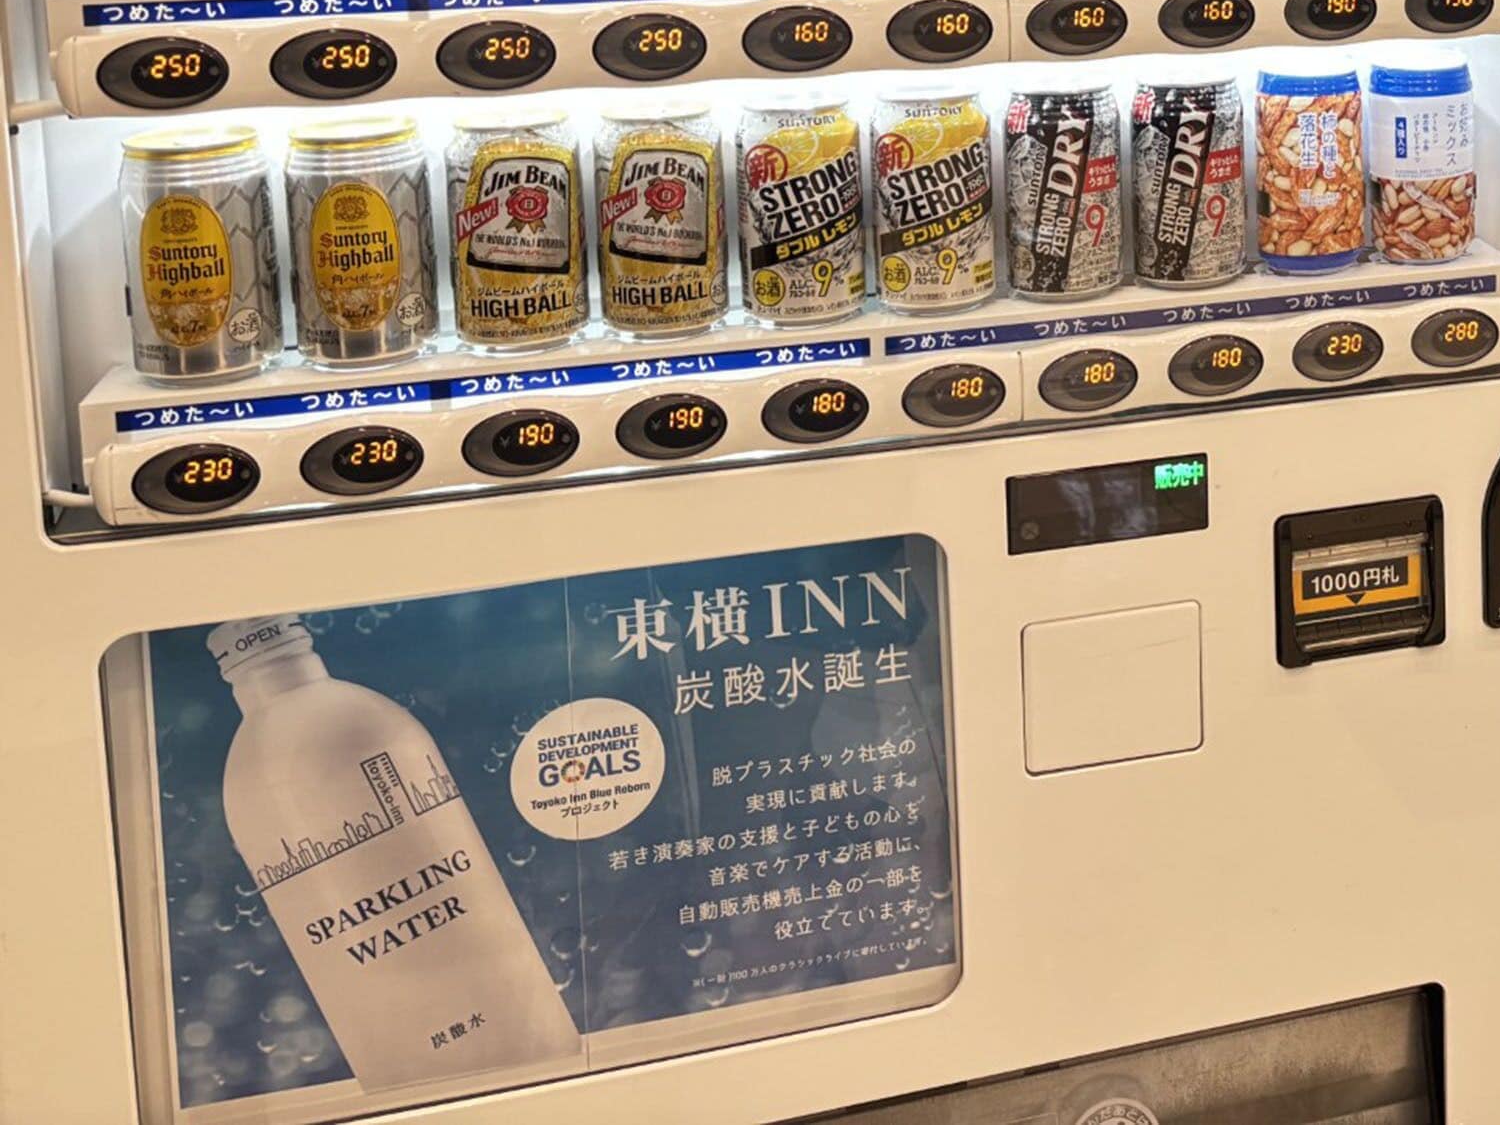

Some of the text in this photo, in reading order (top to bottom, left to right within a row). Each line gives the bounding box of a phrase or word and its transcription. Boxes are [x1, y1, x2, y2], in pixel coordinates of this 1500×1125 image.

[1204, 0, 1234, 21] 160
[793, 20, 829, 44] 160
[484, 36, 531, 61] 250
[150, 53, 201, 80] 250
[1048, 104, 1090, 197] DRY
[1300, 114, 1317, 169] 落花生
[1321, 111, 1337, 178] 柿の種と
[485, 167, 522, 195] JIM
[887, 143, 983, 200] STRONG
[458, 200, 498, 230] New!
[894, 184, 965, 228] ZERO
[902, 203, 984, 247] ダブル レモン
[1036, 193, 1060, 255] STRONG
[1051, 217, 1073, 258] ZERO
[148, 244, 217, 261] Suntory
[147, 258, 225, 286] Highball
[471, 293, 571, 319] HIGH BALL
[612, 283, 707, 306] HIGH BALL
[1327, 333, 1363, 356] 230
[1444, 320, 1480, 343] 280
[1083, 360, 1116, 385] 180
[813, 391, 847, 415] 180
[518, 422, 555, 446] 190
[350, 439, 398, 466] 230
[183, 457, 233, 484] 230
[1154, 461, 1204, 490] 販売中
[1311, 565, 1400, 594] 1000円札
[608, 567, 912, 661] 東横INN
[235, 622, 282, 653] OPEN
[674, 644, 912, 715] 炭酸水誕生
[537, 724, 639, 750] SUSTAINABLE
[538, 737, 638, 763] DEVELOPMENT
[538, 750, 641, 787] GOALS
[712, 737, 916, 787] 脱プラスチック社会の
[531, 782, 650, 810] Toyoko Inn Blue Reborn
[746, 772, 918, 813] 実現に貢献します。
[561, 799, 619, 818] プロジェクト
[608, 799, 922, 871] 若き演奏家の支援と子どもの心を
[708, 836, 921, 887] 音楽でケアする活動に、
[306, 848, 472, 947] SPARKLING
[678, 865, 922, 925] 自動販売機売上金の一部を
[345, 894, 468, 968] WATER
[774, 898, 931, 941] 役立てています。
[430, 1012, 487, 1051] 炭酸水
